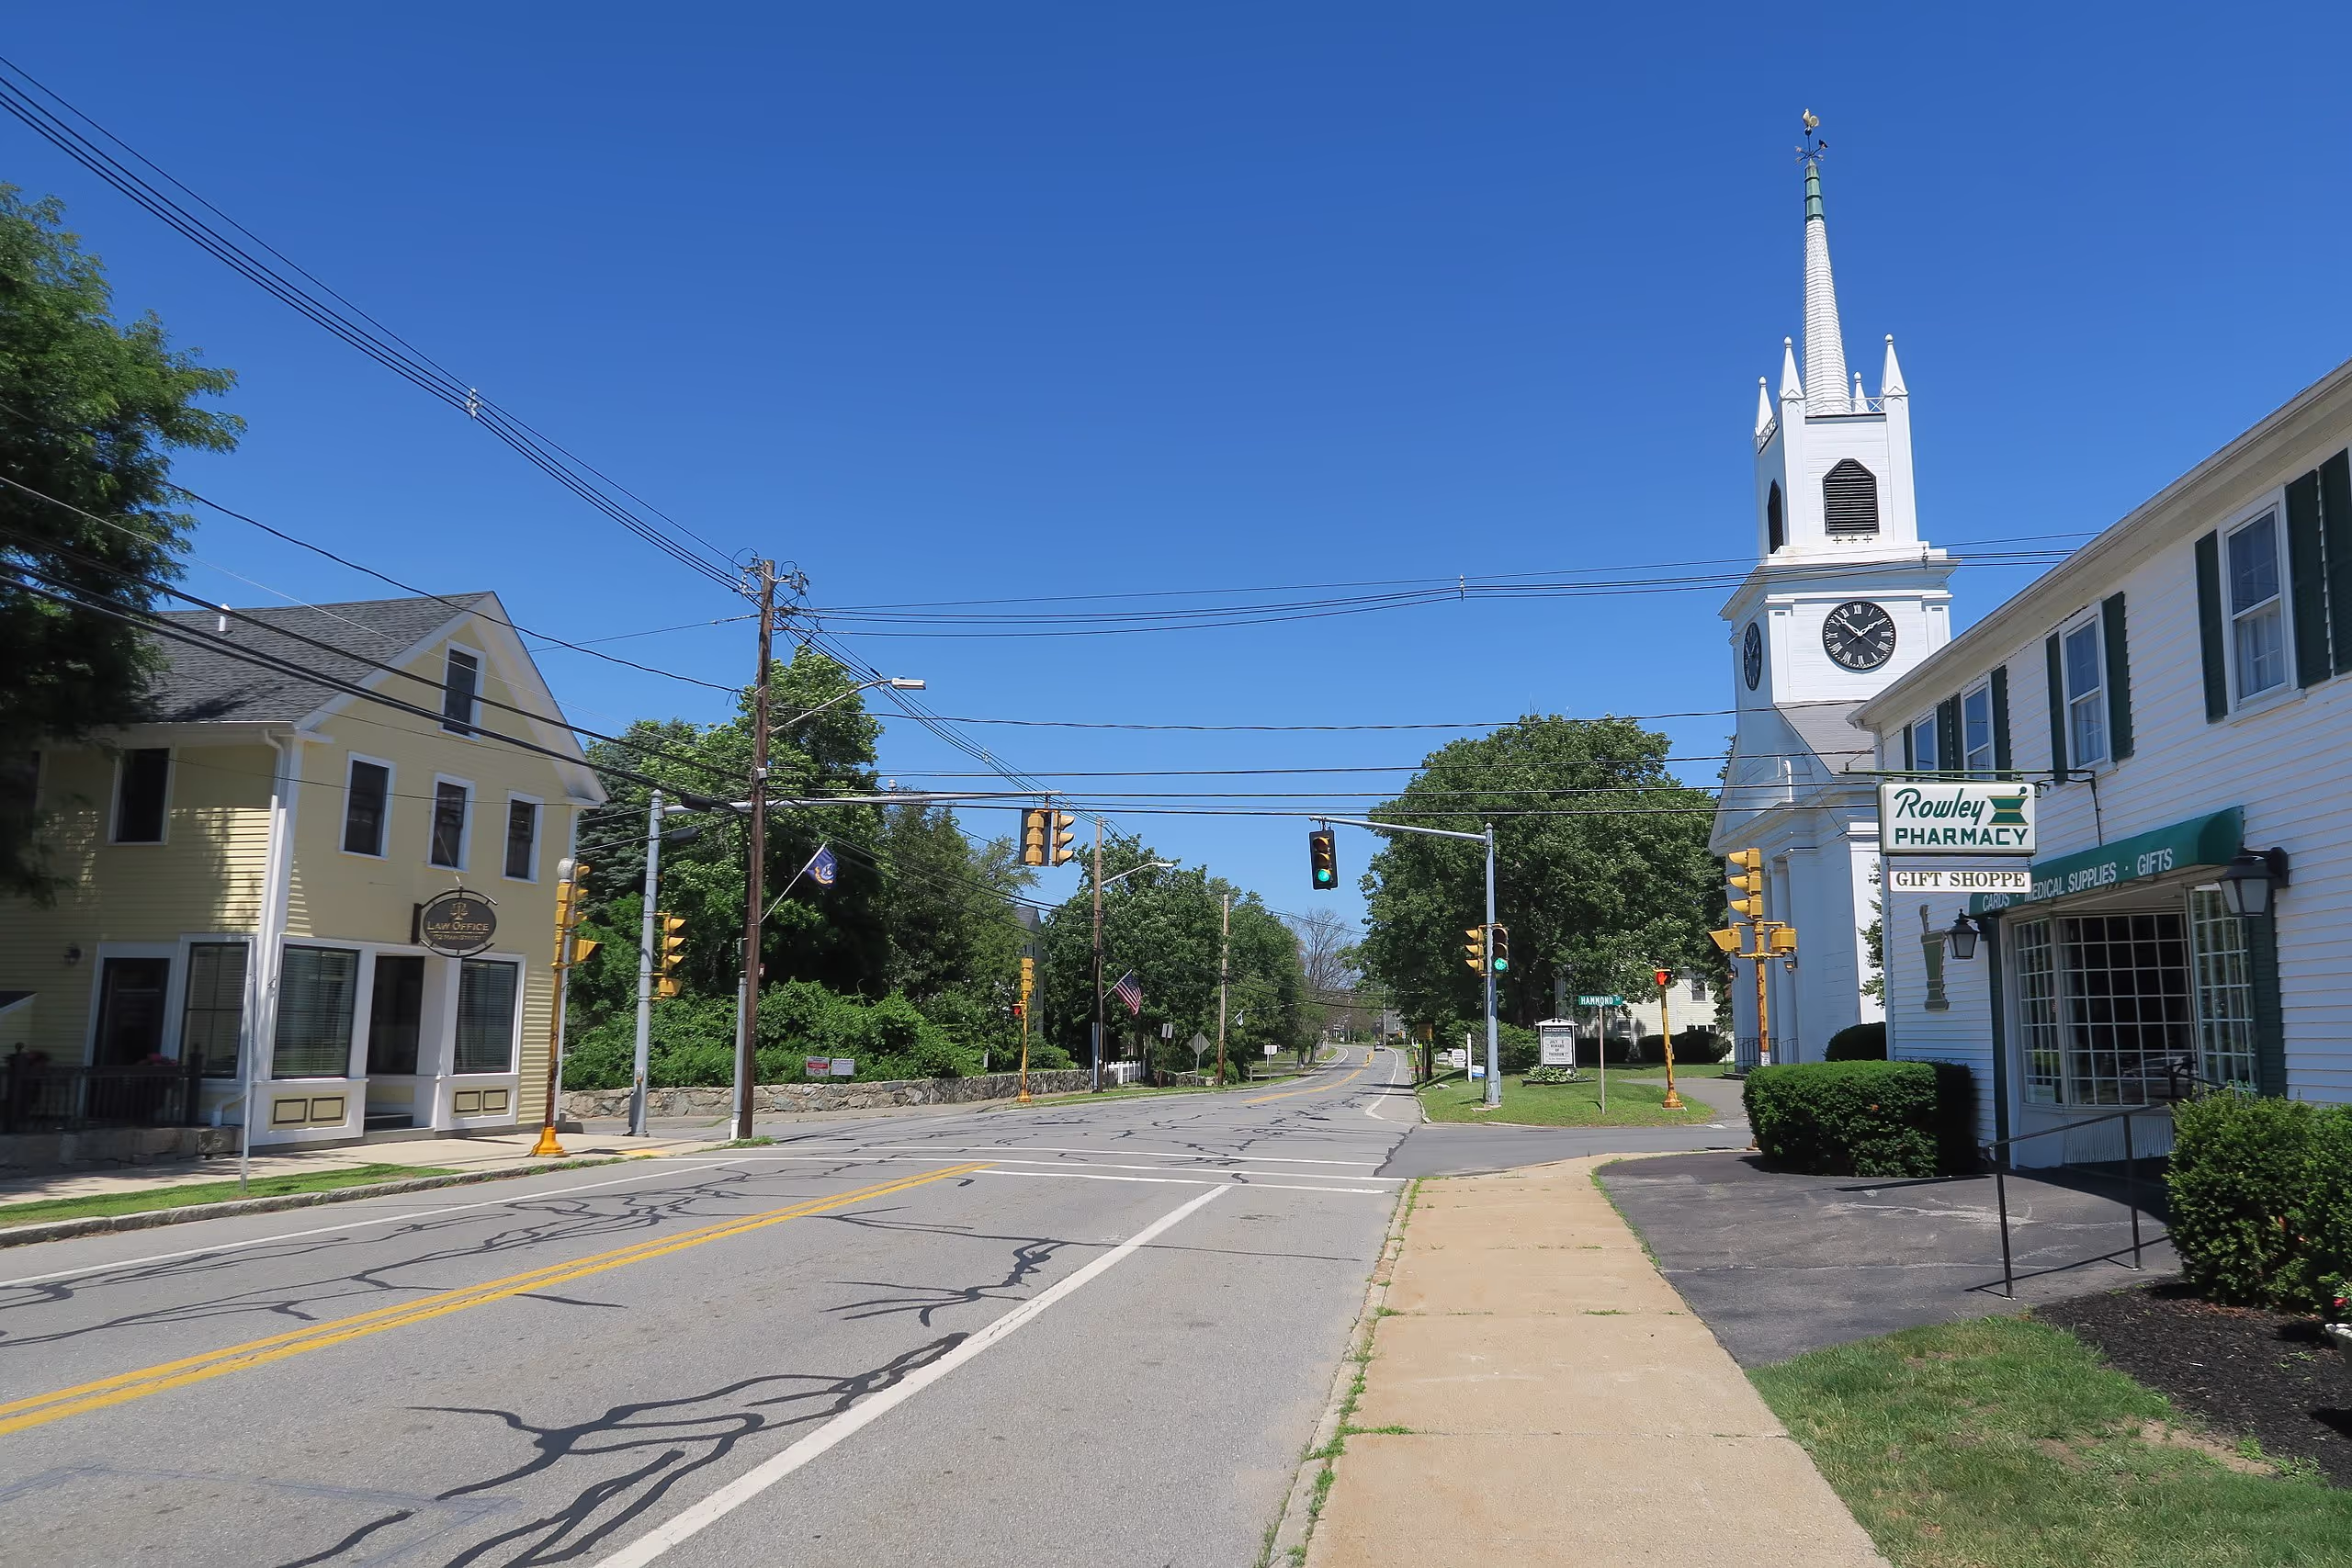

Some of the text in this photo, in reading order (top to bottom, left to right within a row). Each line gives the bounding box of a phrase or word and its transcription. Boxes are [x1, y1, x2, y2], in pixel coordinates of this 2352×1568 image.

[1894, 787, 1985, 826] Rowley
[1895, 828, 2029, 845] PHARMACY
[1896, 872, 2026, 887] GIFT SHOPPE
[1983, 893, 2010, 912] CARDS
[2068, 862, 2117, 892] SUPPLIES
[2137, 848, 2173, 876] GIFTS
[1580, 996, 1613, 1005] HAMMOND
